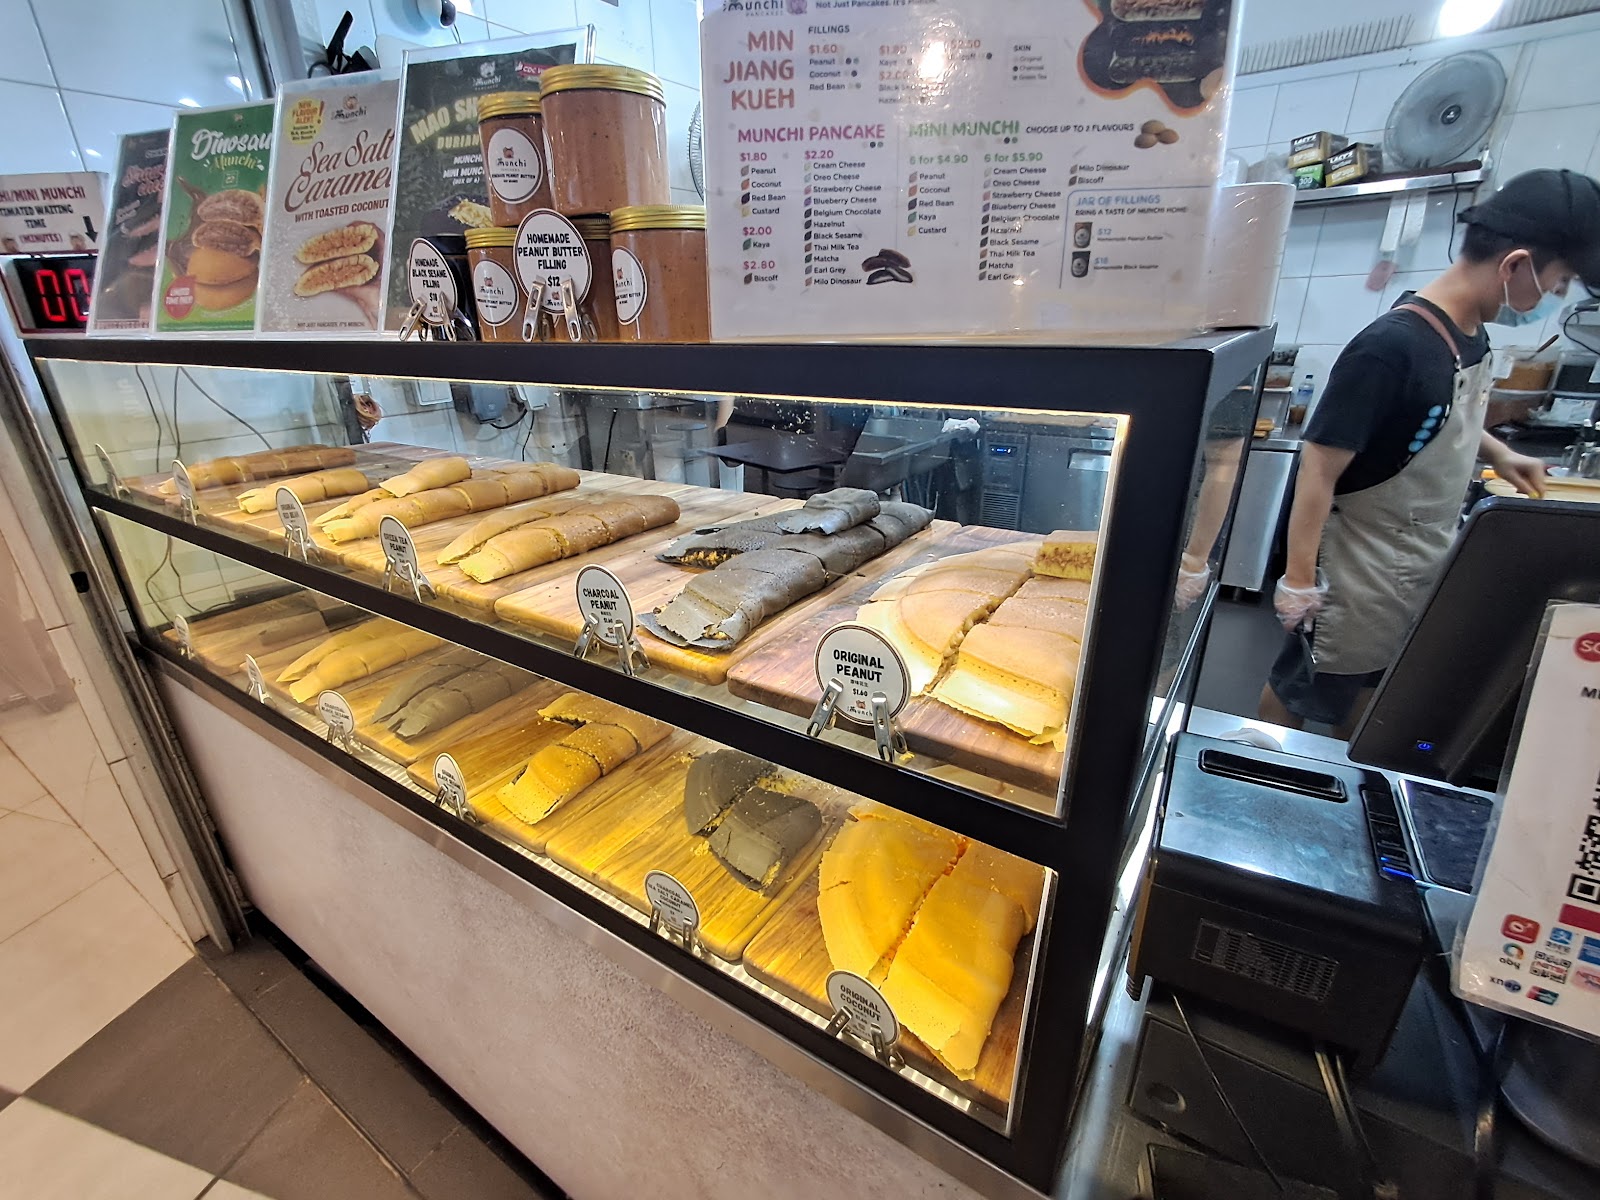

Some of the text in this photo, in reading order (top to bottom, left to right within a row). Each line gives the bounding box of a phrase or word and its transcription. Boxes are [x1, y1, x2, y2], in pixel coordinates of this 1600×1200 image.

[808, 25, 850, 34] FILLINGS
[748, 30, 794, 52] MIN
[809, 44, 838, 54] $1.60
[724, 58, 794, 84] JIANG
[732, 88, 795, 110] KUEH
[410, 106, 450, 144] MAO
[908, 122, 948, 137] MINI
[952, 120, 1020, 136] MUNCHI
[1026, 126, 1058, 134] CHOOSE
[1092, 124, 1134, 132] FLAVOURS
[738, 124, 886, 143] MUNCHI PANCAKE
[437, 134, 480, 150] DURIAN
[300, 128, 394, 176] Sea Salt
[740, 152, 768, 162] $1.80
[804, 150, 834, 160] $2.20
[984, 152, 1043, 162] 6 for $5.90
[910, 154, 968, 165] 6 for $4.90
[443, 168, 460, 178] MINI
[41, 186, 86, 200] MUNCHI
[992, 191, 1032, 199] Strawberry
[814, 198, 848, 206] Blueberry
[1077, 195, 1160, 206] JAR OF FILLINGS
[36, 204, 74, 214] WAITING
[295, 199, 389, 222] WITH TOASTED COCONUT
[814, 209, 843, 217] Belgium
[992, 204, 1028, 212] Blueberry
[24, 219, 47, 228] TIME
[742, 226, 772, 236] $2.00
[527, 234, 570, 244] HOMEMADE
[752, 241, 770, 249] Kaya
[518, 247, 584, 256] PEANUT BUTTER
[415, 258, 439, 268] HOMEMADE
[538, 260, 566, 270] FILLING
[743, 260, 776, 270] $2.80
[412, 269, 448, 278] BLACK SESAME
[830, 266, 846, 274] Grey
[754, 274, 778, 282] Biscoff
[423, 280, 440, 288] FILLING
[384, 533, 408, 546] GREEN TEA
[583, 588, 620, 600] CHARCOAL
[590, 600, 617, 610] PEANUT
[833, 649, 884, 670] ORIGINAL
[836, 664, 882, 682] PEANUT
[852, 688, 868, 697] $1.60
[1581, 687, 1600, 700] M
[840, 984, 880, 1014] ORIGINAL
[840, 994, 880, 1022] COCONUT
